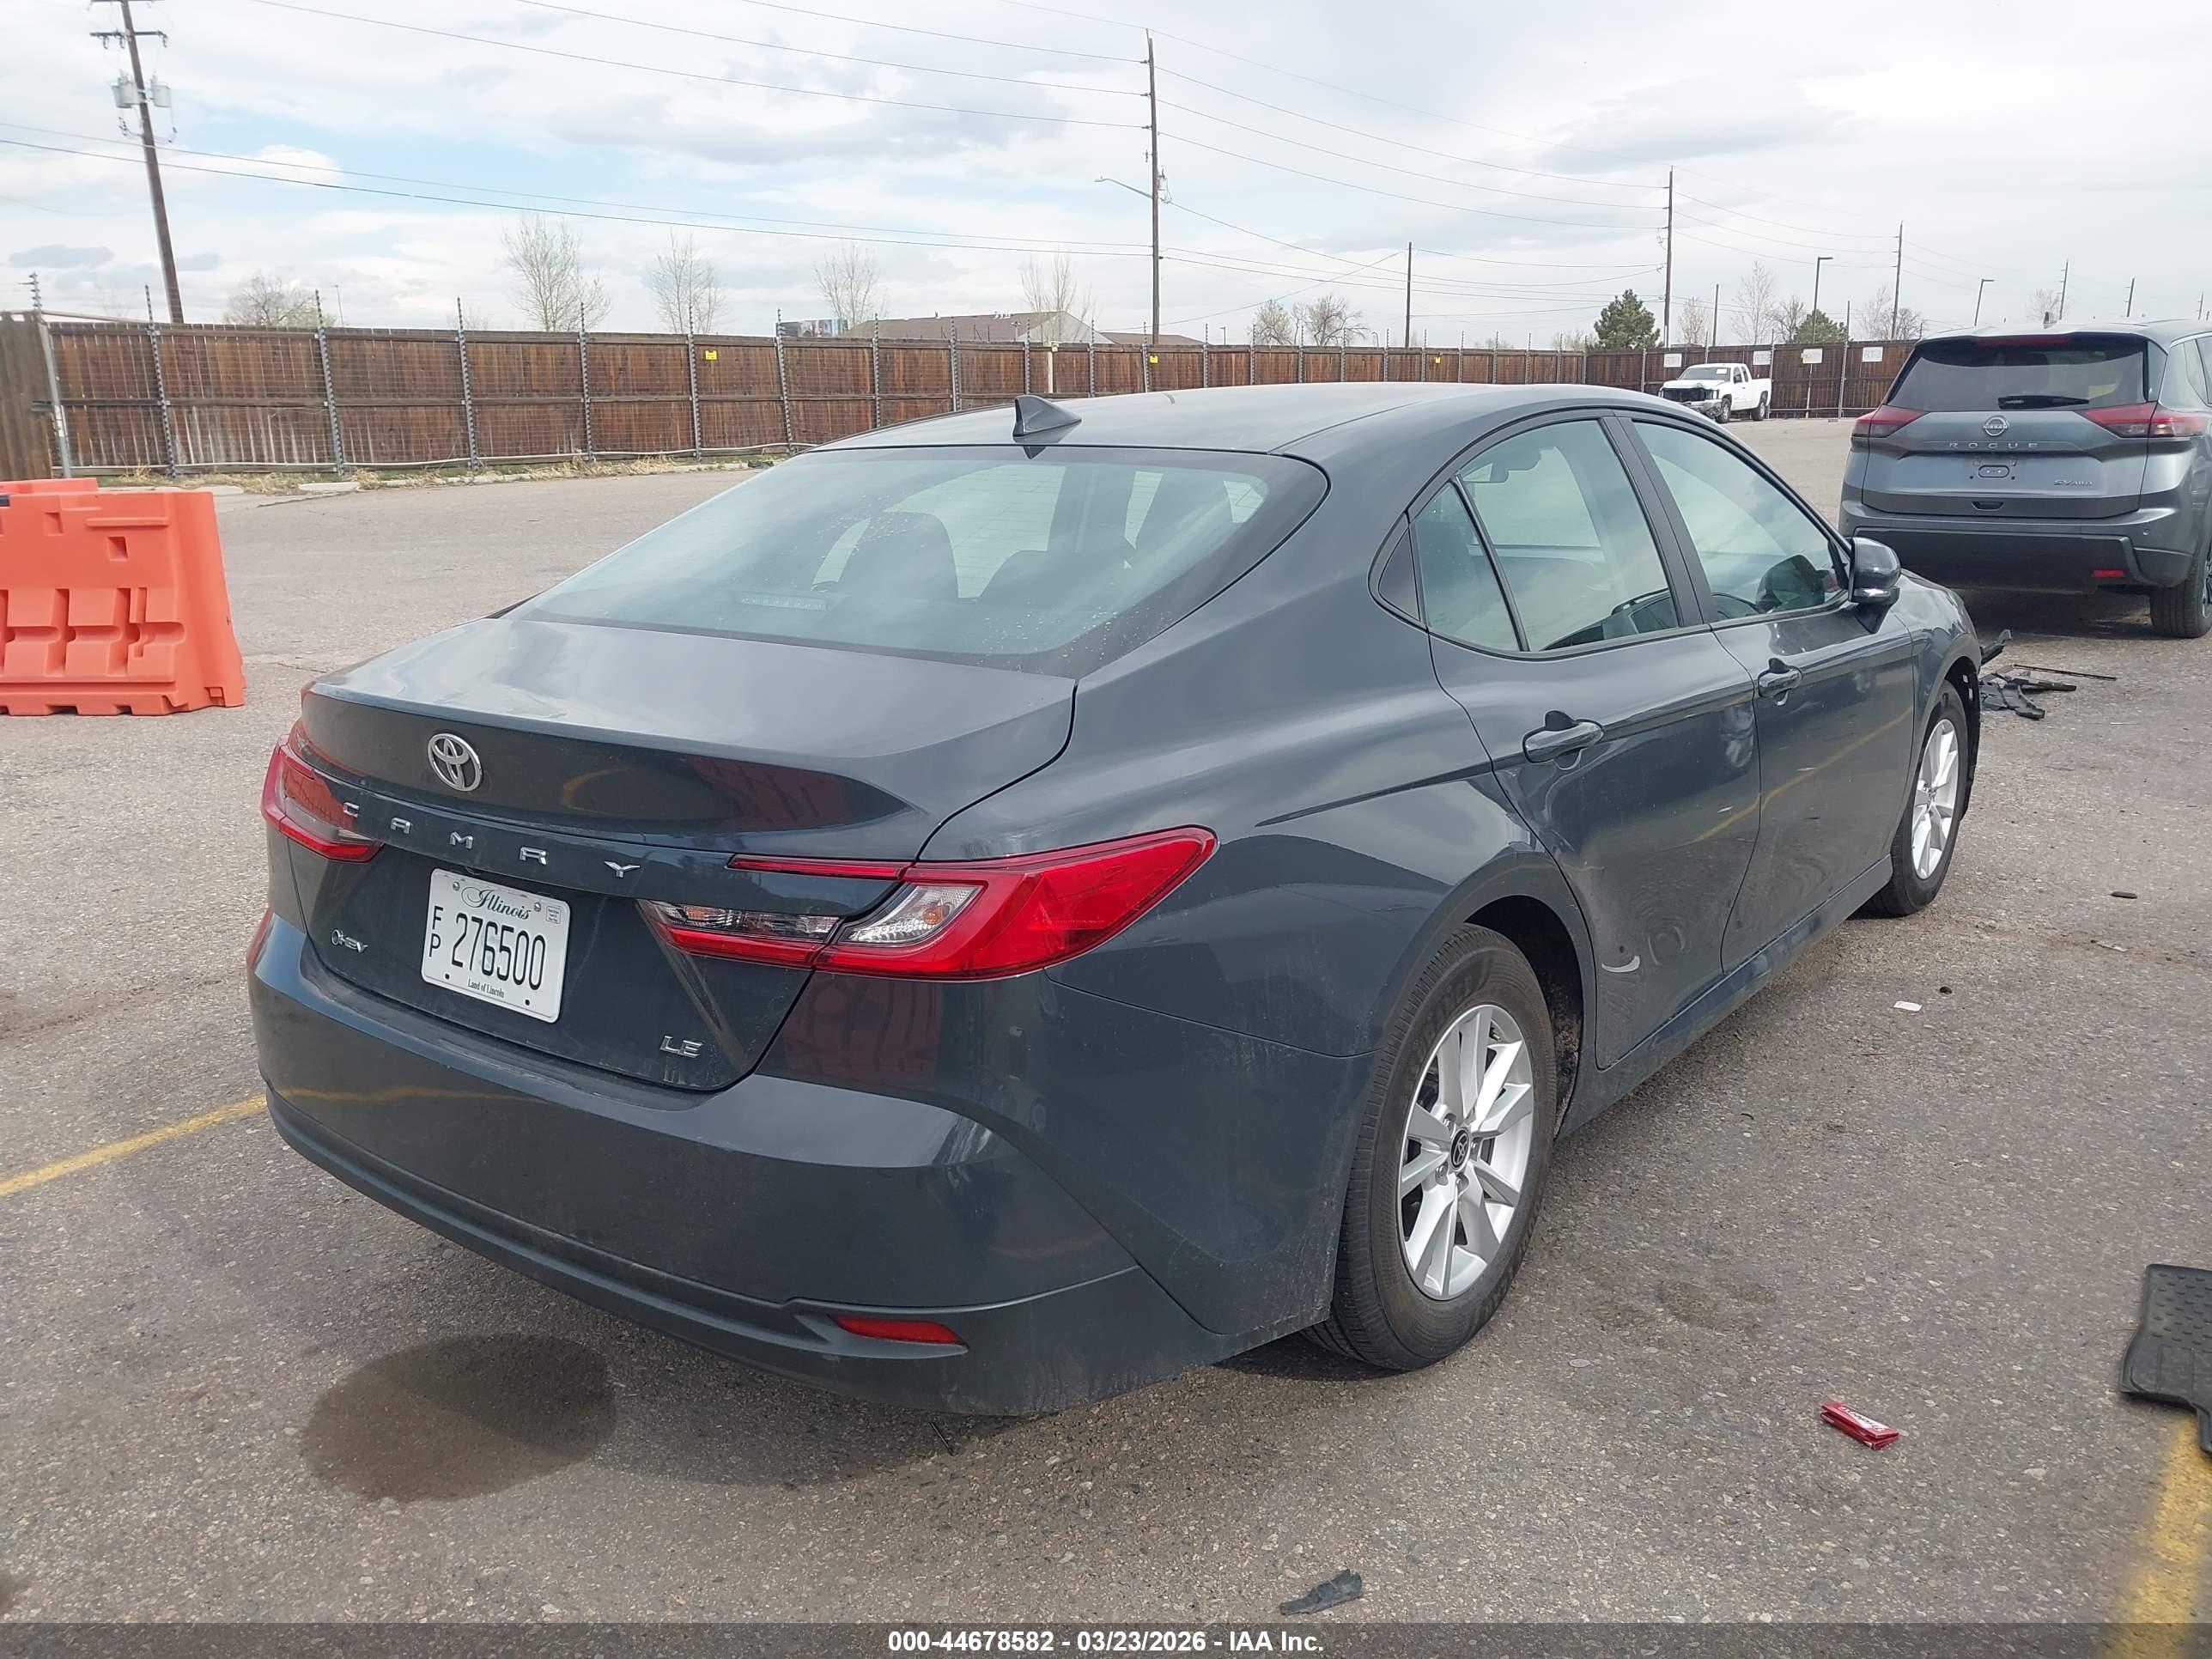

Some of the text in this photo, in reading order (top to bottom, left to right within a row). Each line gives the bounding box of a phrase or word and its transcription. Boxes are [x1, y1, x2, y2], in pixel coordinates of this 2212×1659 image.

[343, 802, 641, 878] CAMRY
[461, 886, 532, 920] Illinois
[451, 912, 546, 990] 276500
[468, 978, 481, 990] Land
[487, 984, 505, 999] Lincoln
[659, 1035, 704, 1059] LE
